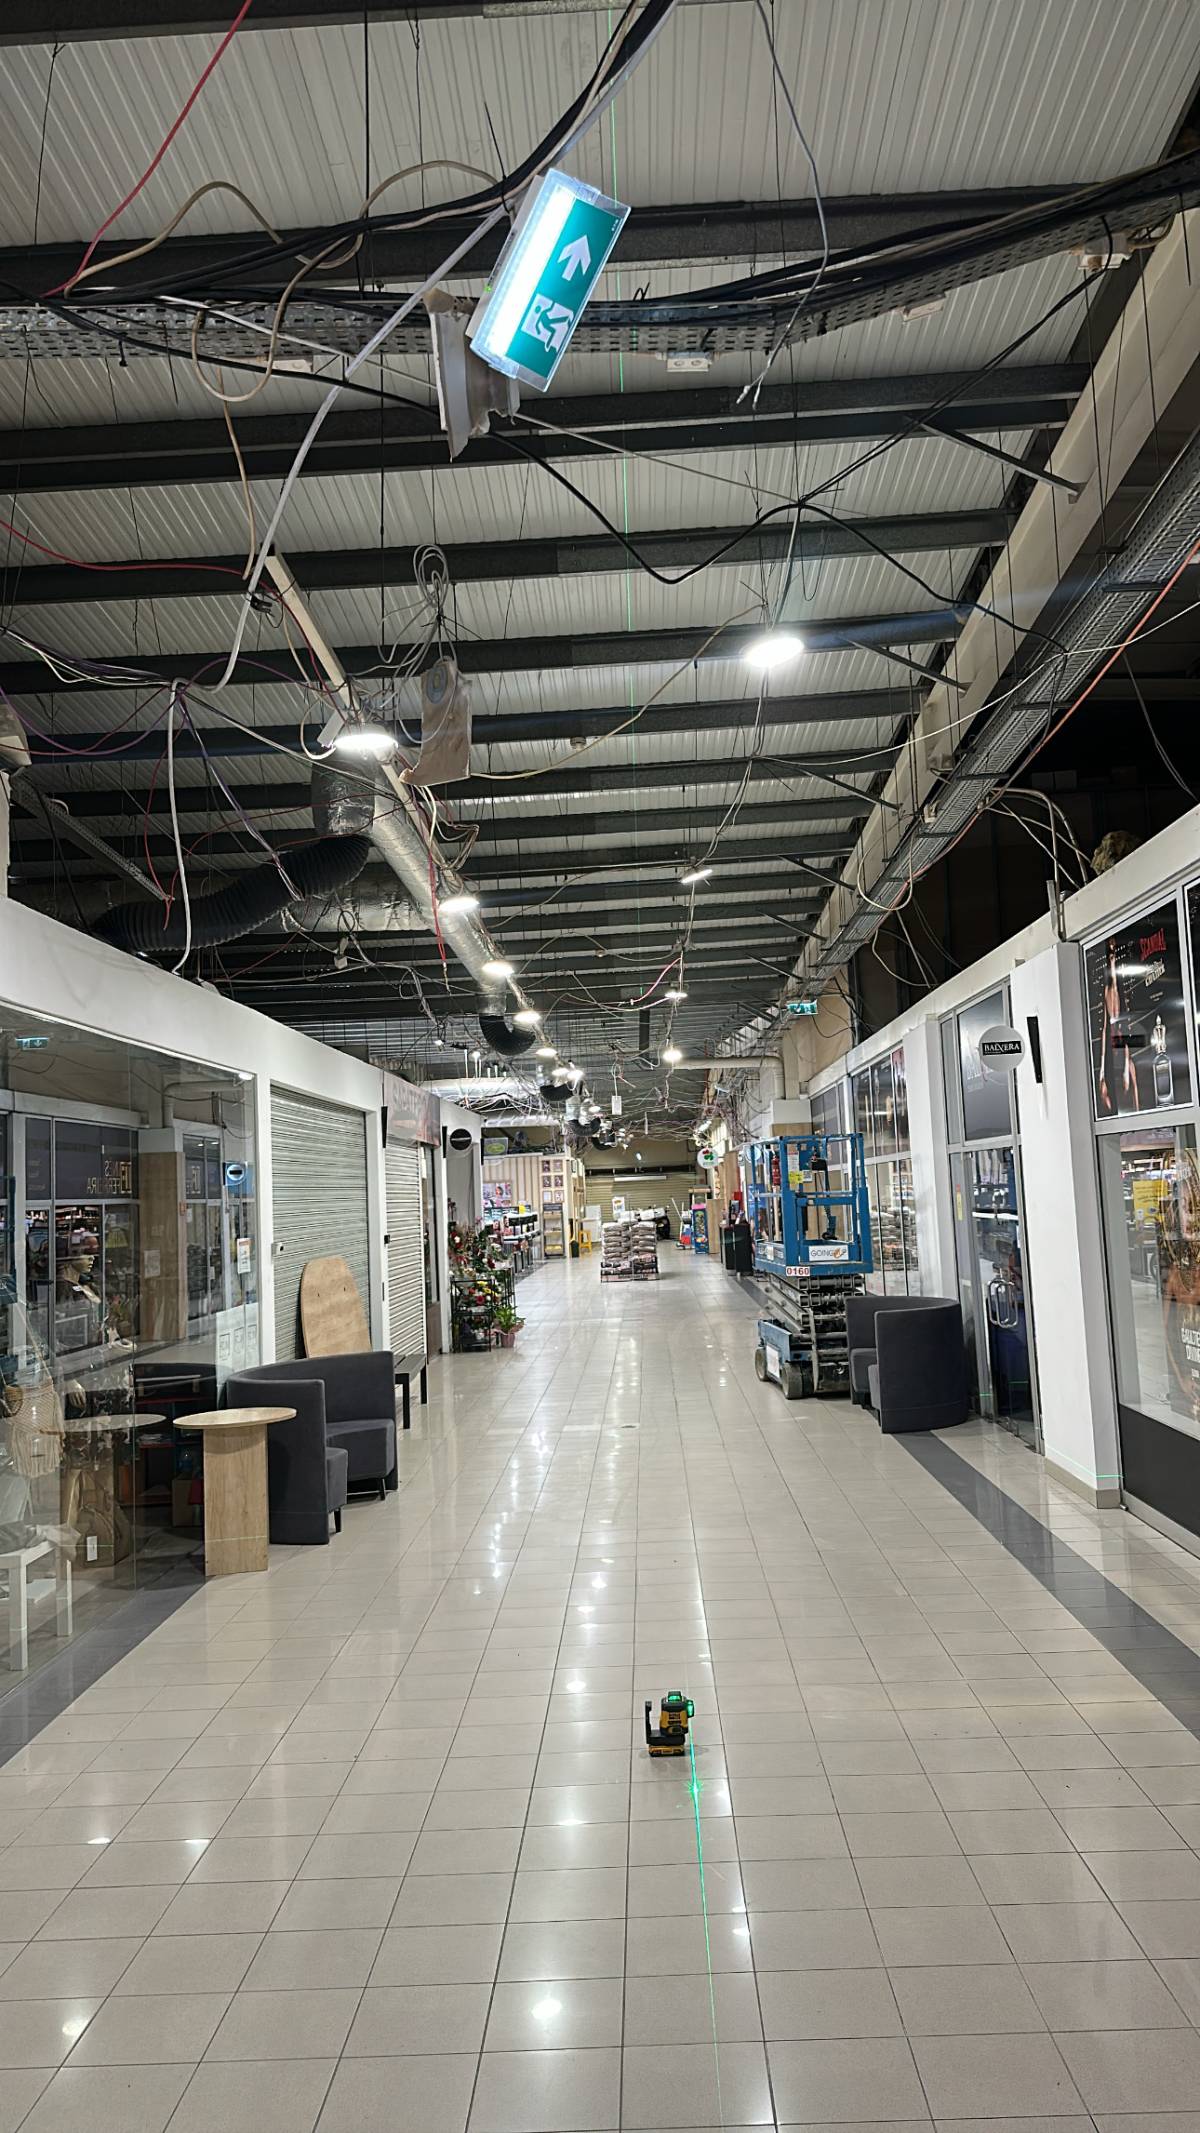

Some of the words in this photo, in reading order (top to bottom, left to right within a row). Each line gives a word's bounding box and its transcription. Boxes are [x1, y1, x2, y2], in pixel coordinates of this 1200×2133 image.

[984, 1043, 1020, 1052] BALVERA
[810, 1249, 833, 1257] GOING
[786, 1267, 809, 1275] 0160
